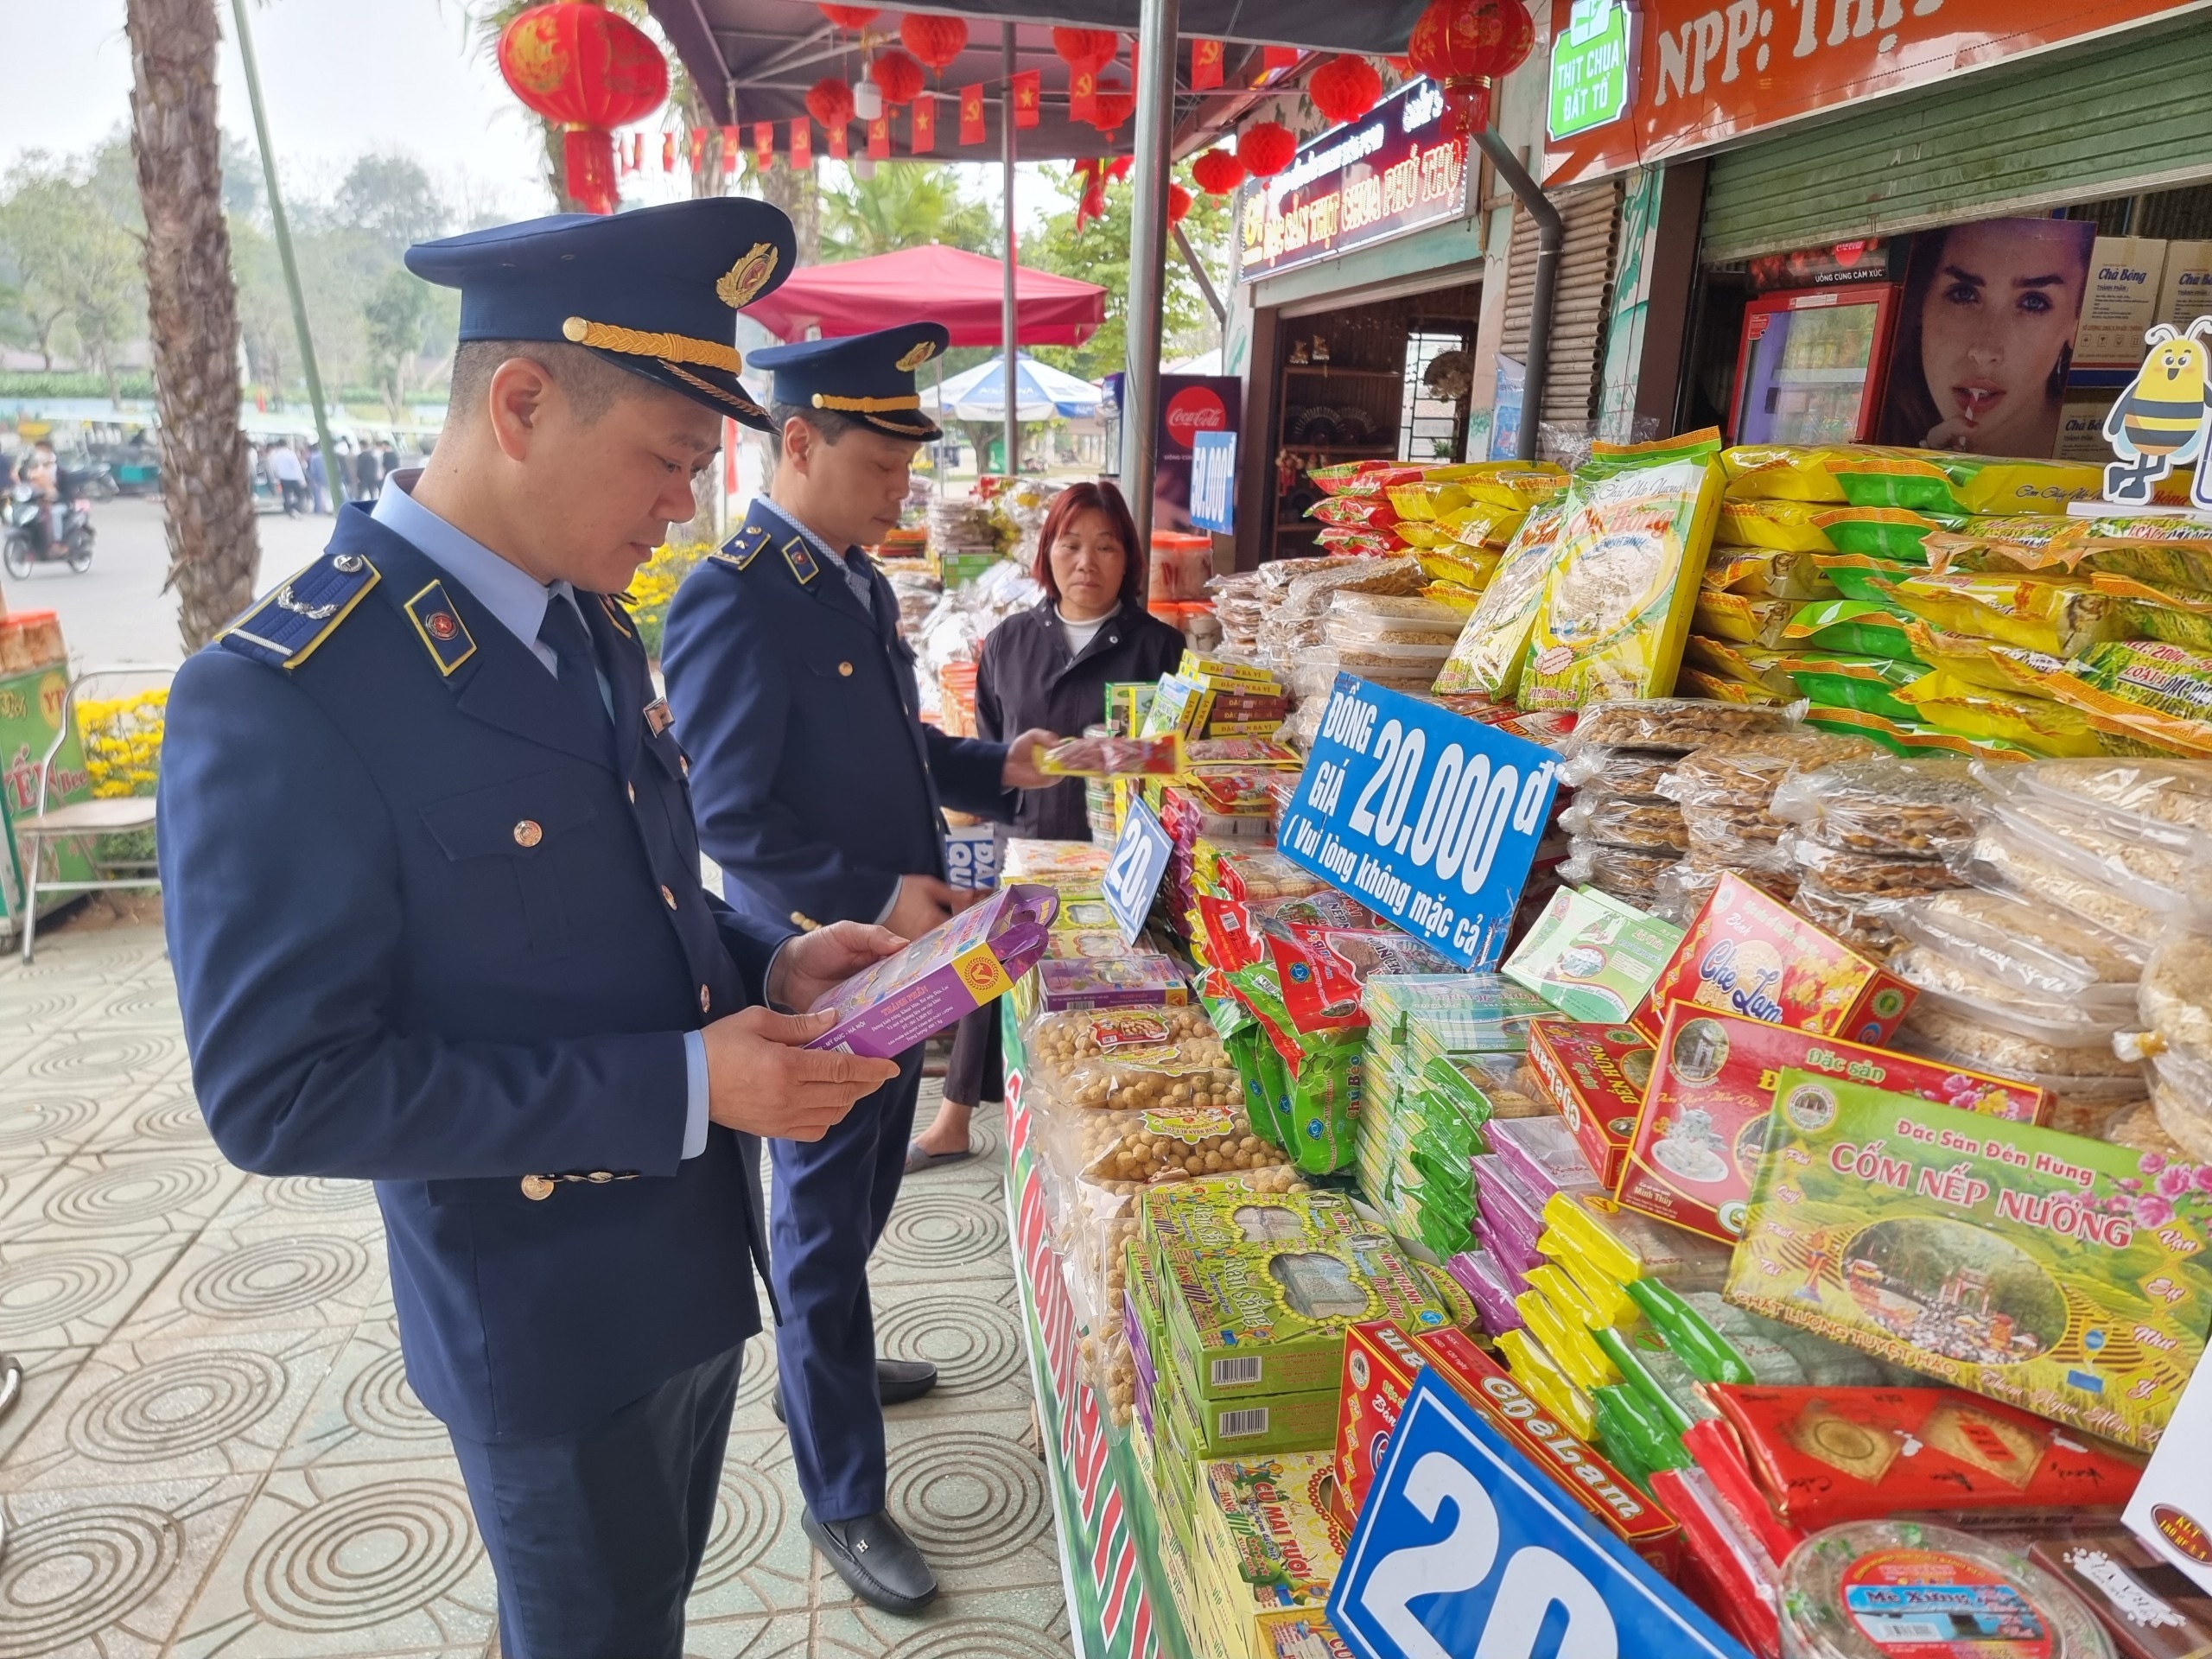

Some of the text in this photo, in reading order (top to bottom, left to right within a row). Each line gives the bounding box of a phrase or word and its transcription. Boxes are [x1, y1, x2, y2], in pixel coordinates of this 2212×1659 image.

[1557, 39, 1619, 91] THỊT CHUA
[1655, 9, 1772, 105] NPP:
[1563, 72, 1611, 123] ĐẤT TỔ
[1342, 175, 1382, 232] CHUA
[1383, 143, 1420, 216] PHÚ
[1421, 138, 1462, 207] THỌ
[2120, 268, 2147, 284] Bông
[1322, 682, 1378, 754] ĐỒNG
[1542, 689, 1559, 700] 200g
[1308, 719, 1556, 895] GIÁ 20.000đ
[1294, 817, 1323, 862] Vui
[1318, 833, 1357, 883] lòng
[1355, 854, 1412, 916] không
[1408, 891, 1453, 940] mặc
[1453, 913, 1484, 957] cả
[1732, 966, 1783, 1025] Lam
[833, 1032, 846, 1043] ĐỨC
[847, 1025, 856, 1034] HÀ
[855, 1020, 866, 1030] NỘI
[1345, 1053, 1362, 1089] Béo
[1807, 1047, 1887, 1083] Đặc sản
[1830, 1139, 1911, 1189] CỐM
[1916, 1162, 1990, 1208] NẾP
[1896, 1118, 2096, 1188] Đặc Sản Đền Hùng
[1224, 1258, 1249, 1290] Rau
[1378, 1253, 1402, 1273] KIM
[1391, 1271, 1426, 1306] THÀNH
[1546, 1430, 1645, 1521] Lam
[1254, 1514, 1266, 1534] ngon
[1263, 1505, 1293, 1536] MÀI
